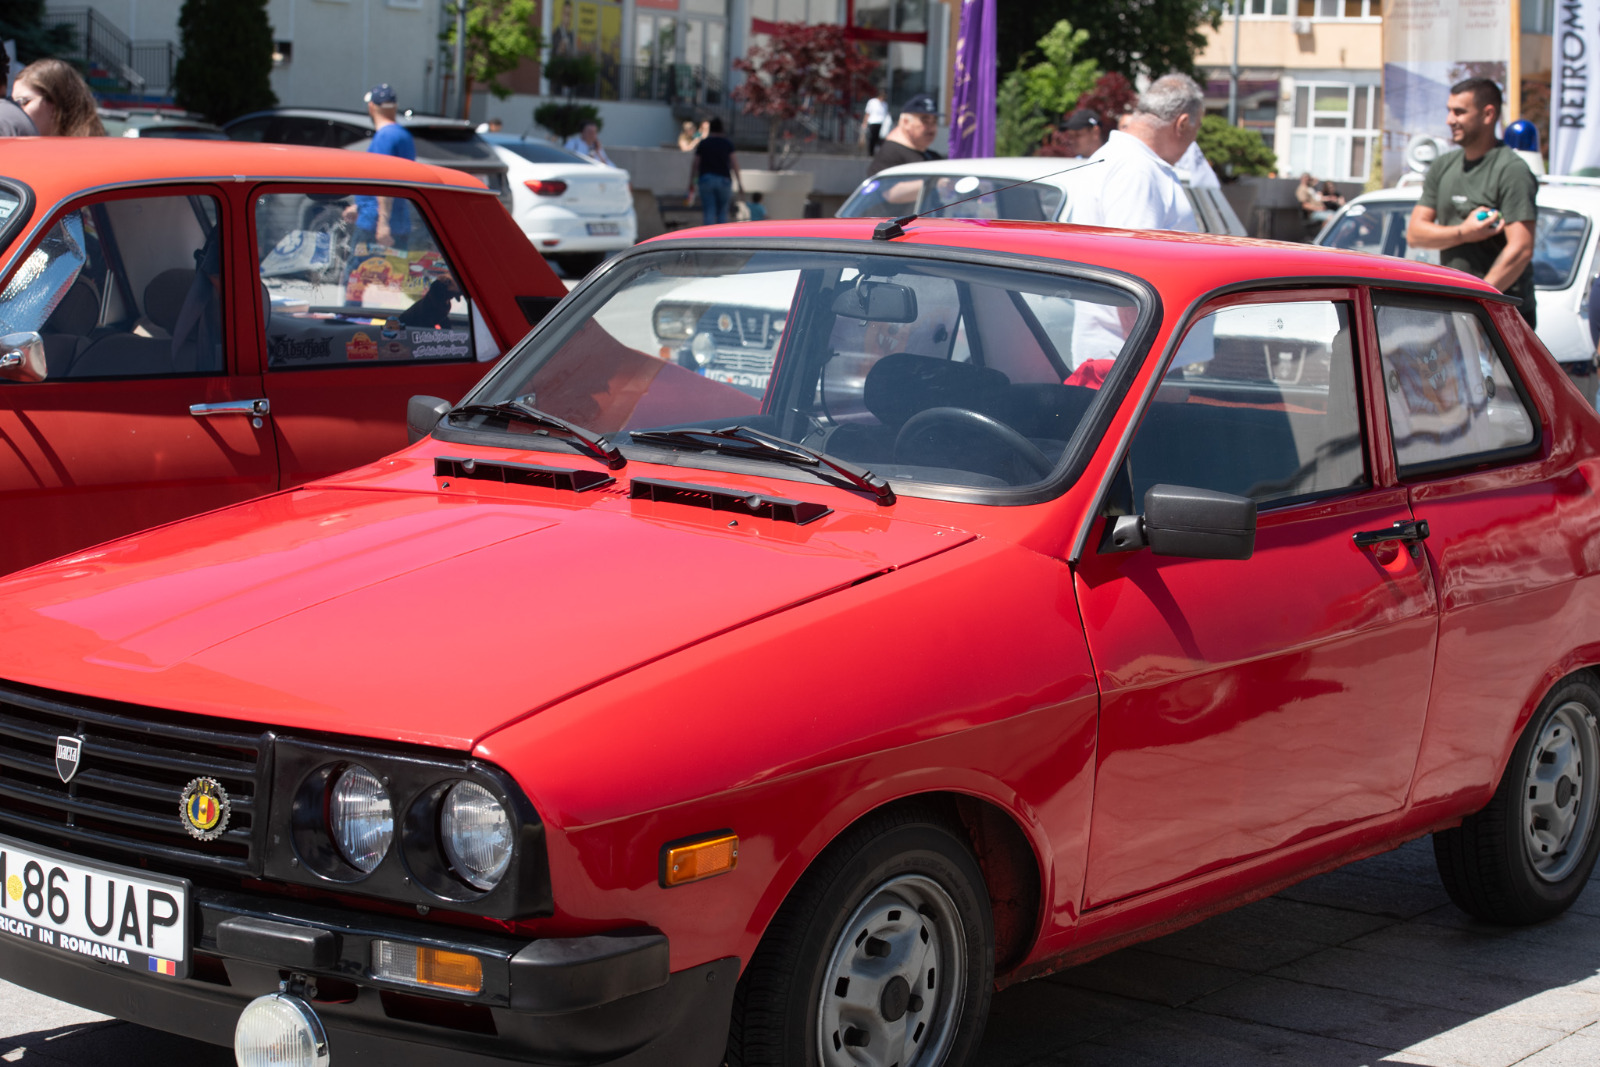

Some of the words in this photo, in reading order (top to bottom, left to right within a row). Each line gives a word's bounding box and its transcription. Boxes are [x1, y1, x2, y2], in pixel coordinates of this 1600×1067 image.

[1559, 0, 1586, 128] RETROM
[57, 744, 78, 762] DACIA
[23, 860, 69, 925] 86
[85, 875, 179, 949] UAP
[39, 928, 54, 944] IN
[60, 934, 130, 965] ROMANIA
